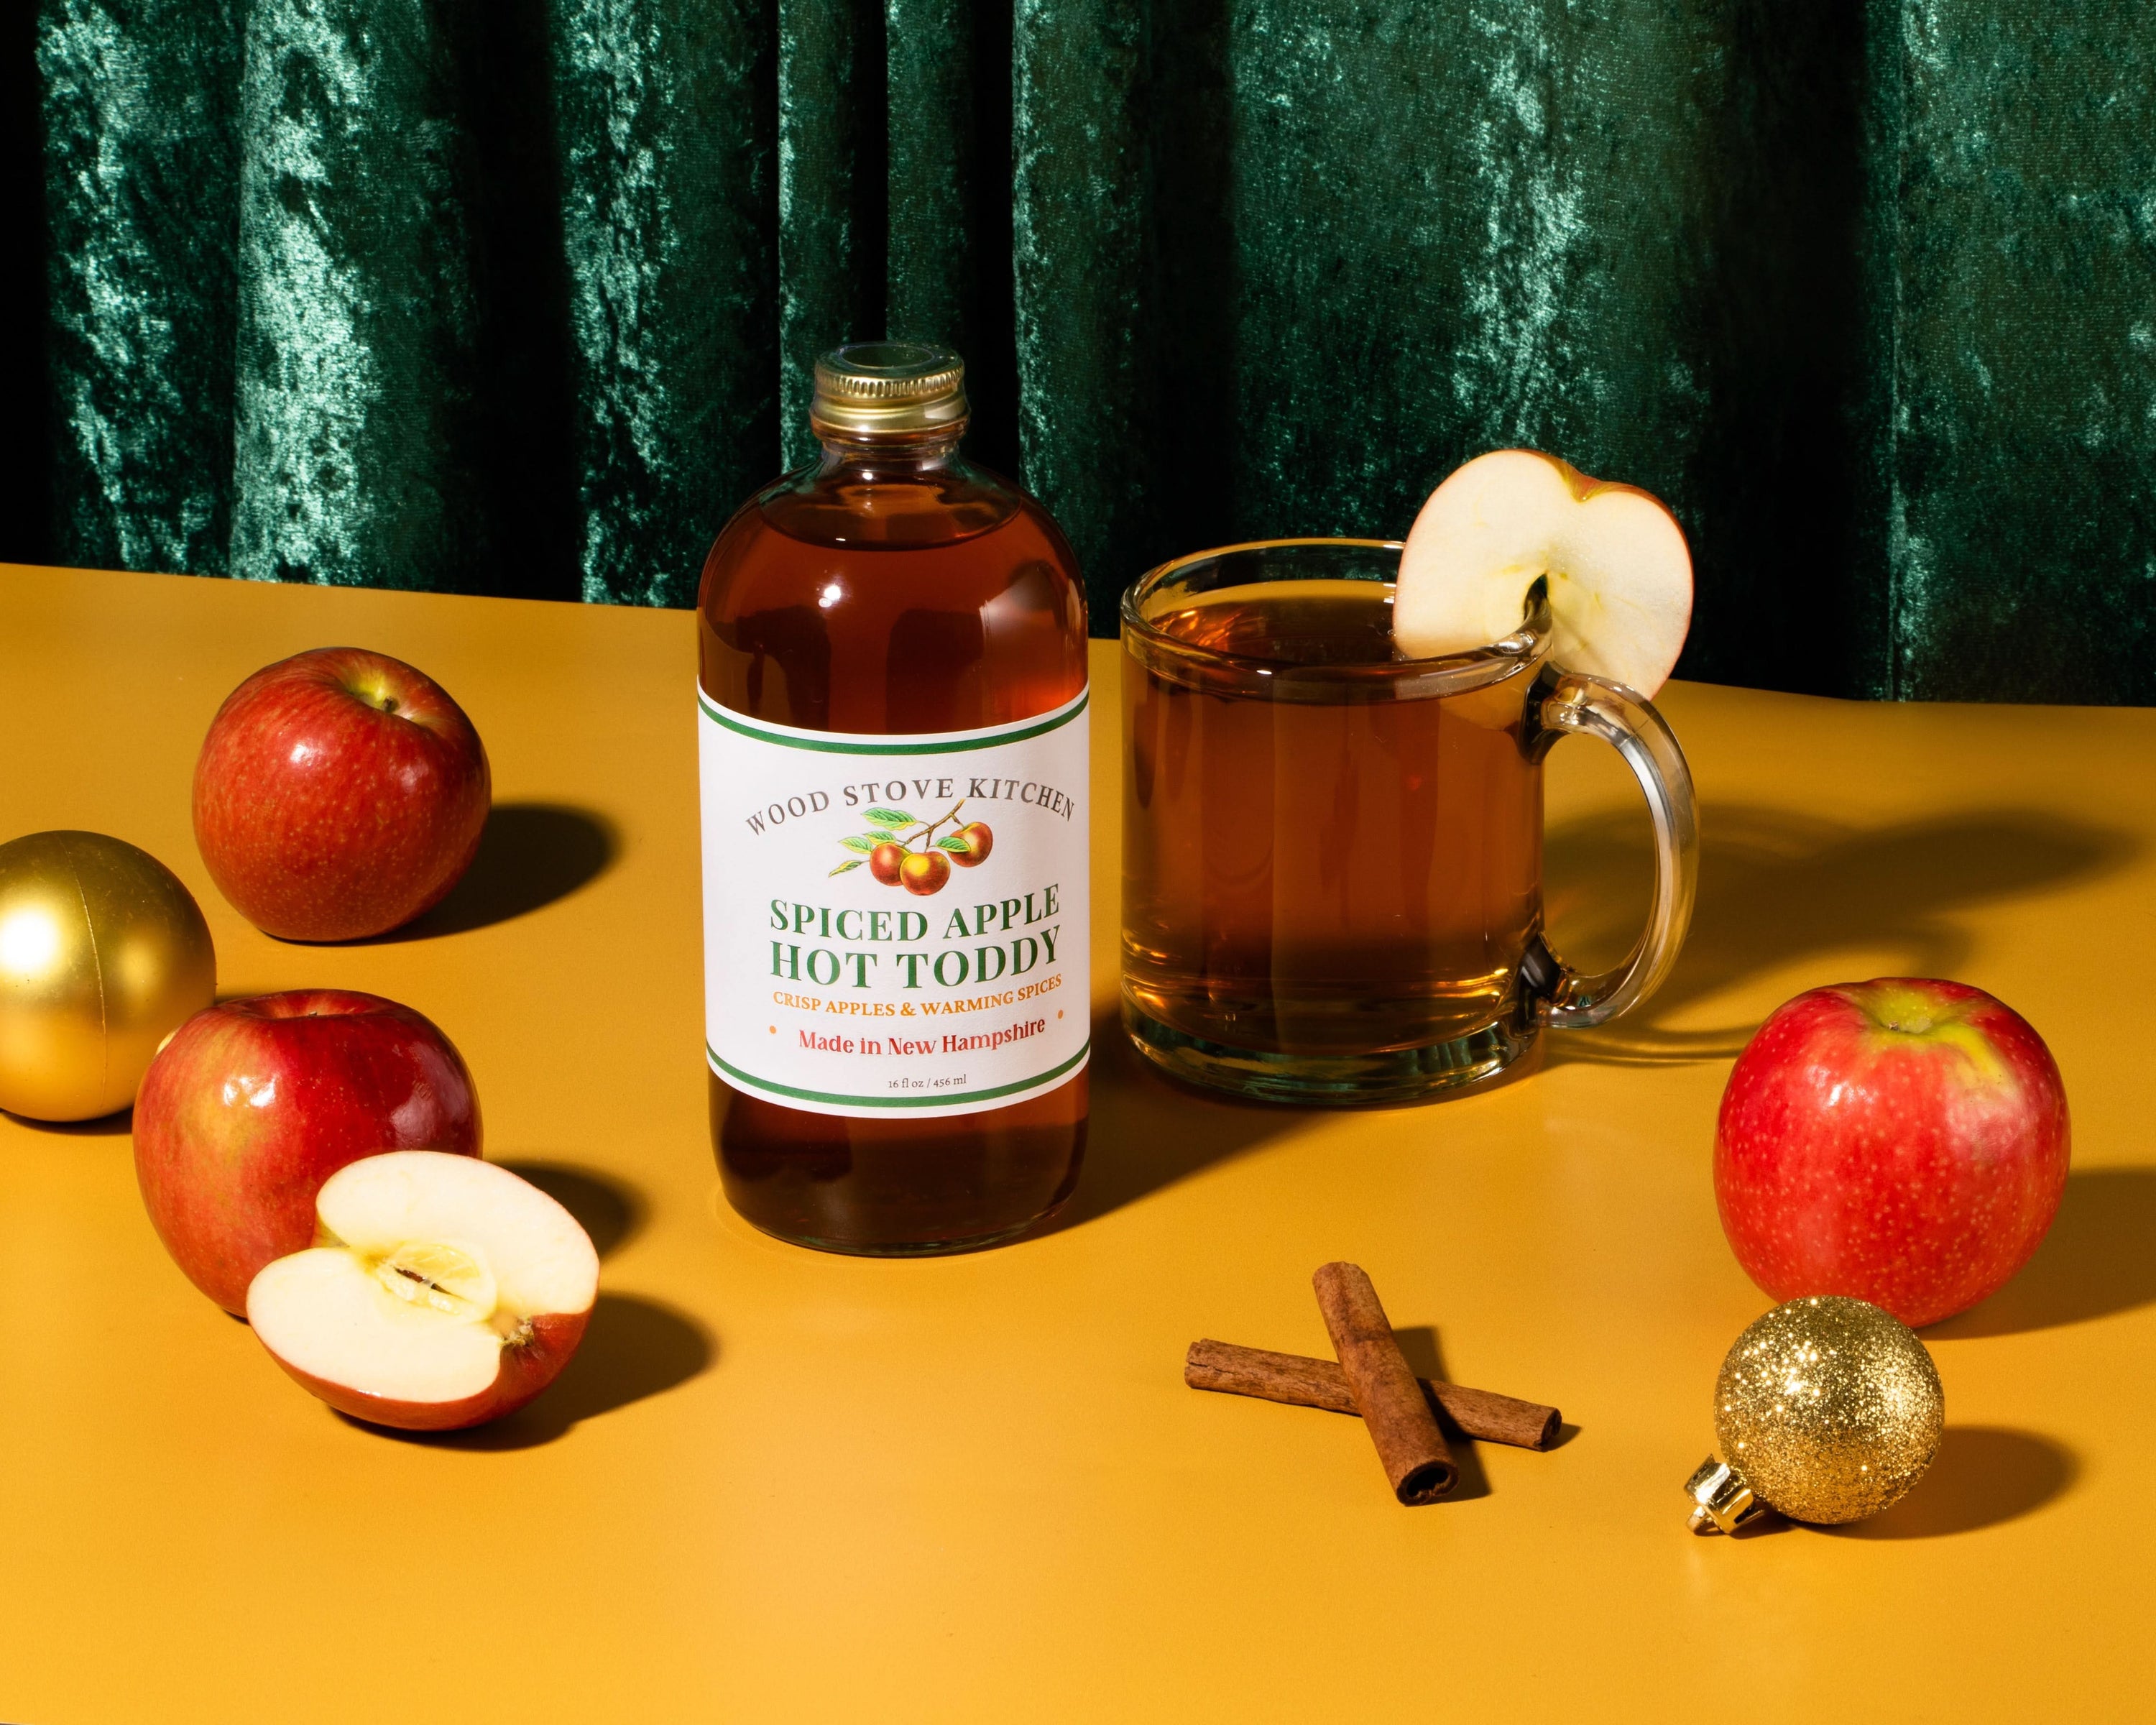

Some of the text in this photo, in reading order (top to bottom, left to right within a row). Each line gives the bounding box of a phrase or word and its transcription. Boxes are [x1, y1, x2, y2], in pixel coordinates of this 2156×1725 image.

[745, 777, 1075, 837] WOOD STOVE KITCHEN
[770, 883, 1059, 942] SPICED APPLE
[770, 924, 1060, 989] HOT TODDY
[773, 973, 1062, 1016] CRISP APPLES & WARMING SPICES
[798, 1018, 1045, 1055] Made in New Hampshire
[888, 1079, 899, 1088] 16
[901, 1077, 909, 1088] fl
[926, 1078, 931, 1088] /
[934, 1078, 950, 1087] 456
[953, 1074, 967, 1085] ml
